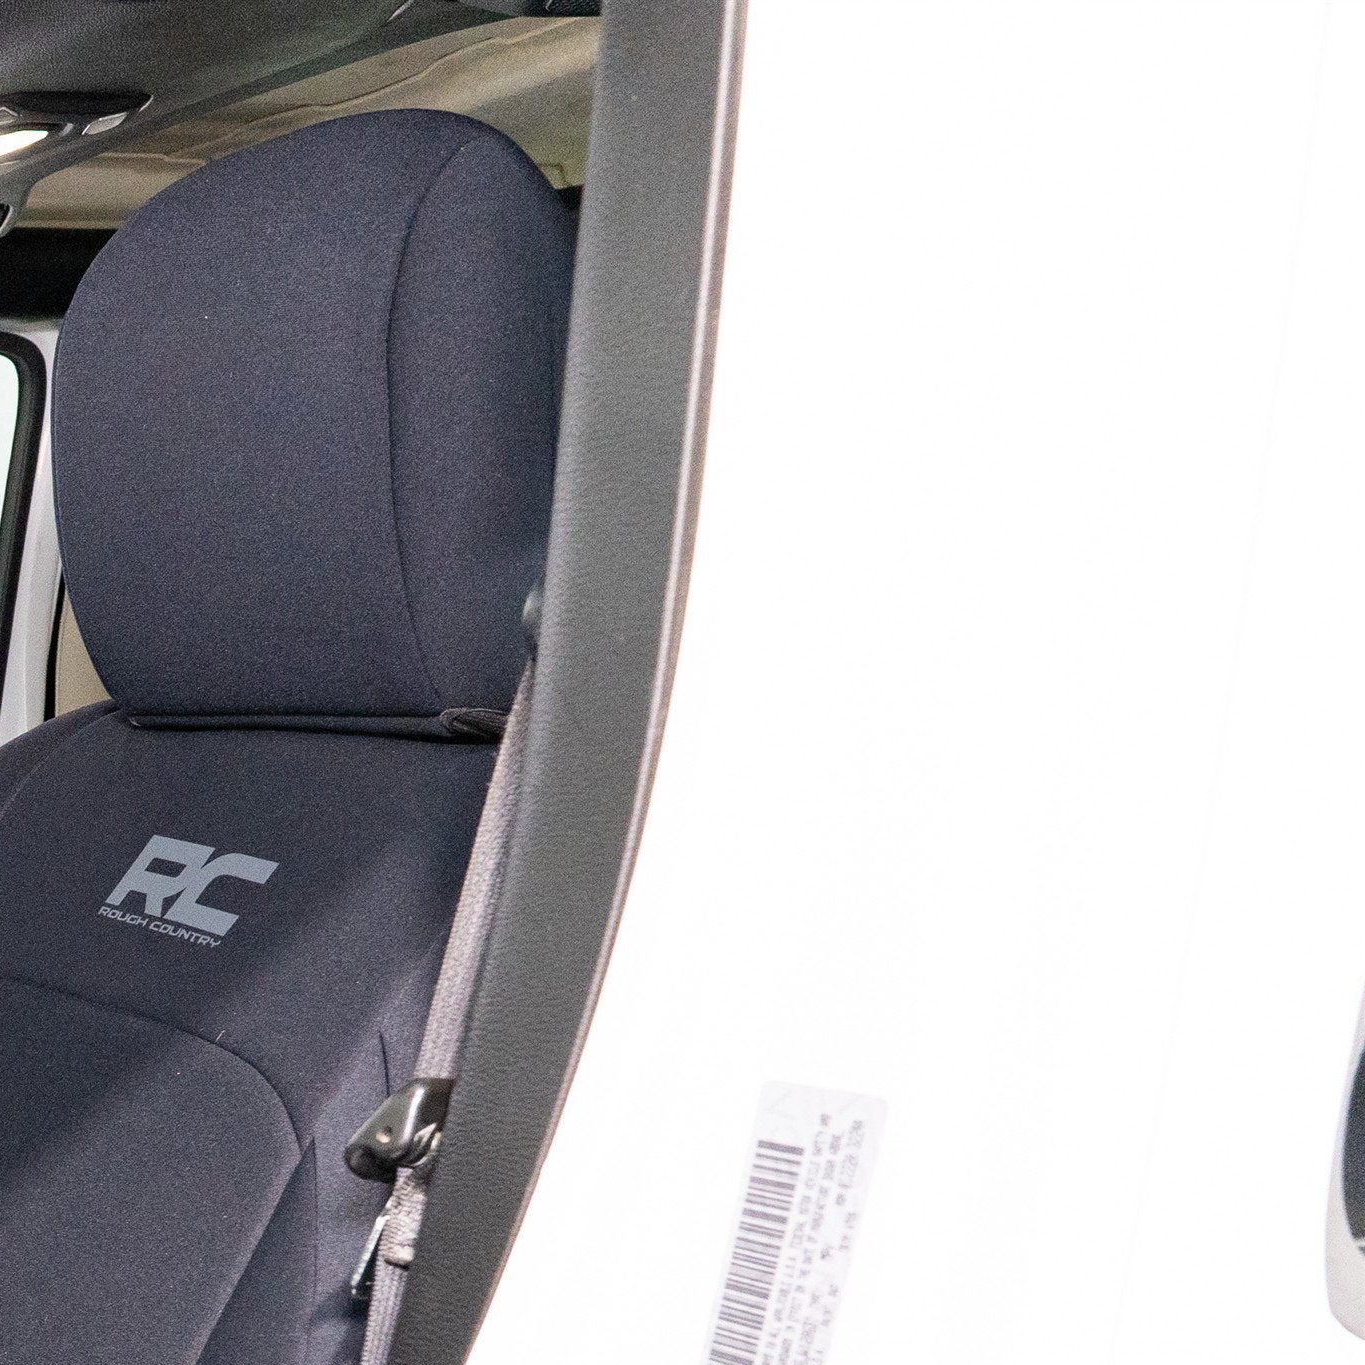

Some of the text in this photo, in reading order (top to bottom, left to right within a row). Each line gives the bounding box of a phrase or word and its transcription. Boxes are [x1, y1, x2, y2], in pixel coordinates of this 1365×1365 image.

[104, 834, 280, 937] RC
[97, 905, 222, 949] ROUGH COUNTRY
